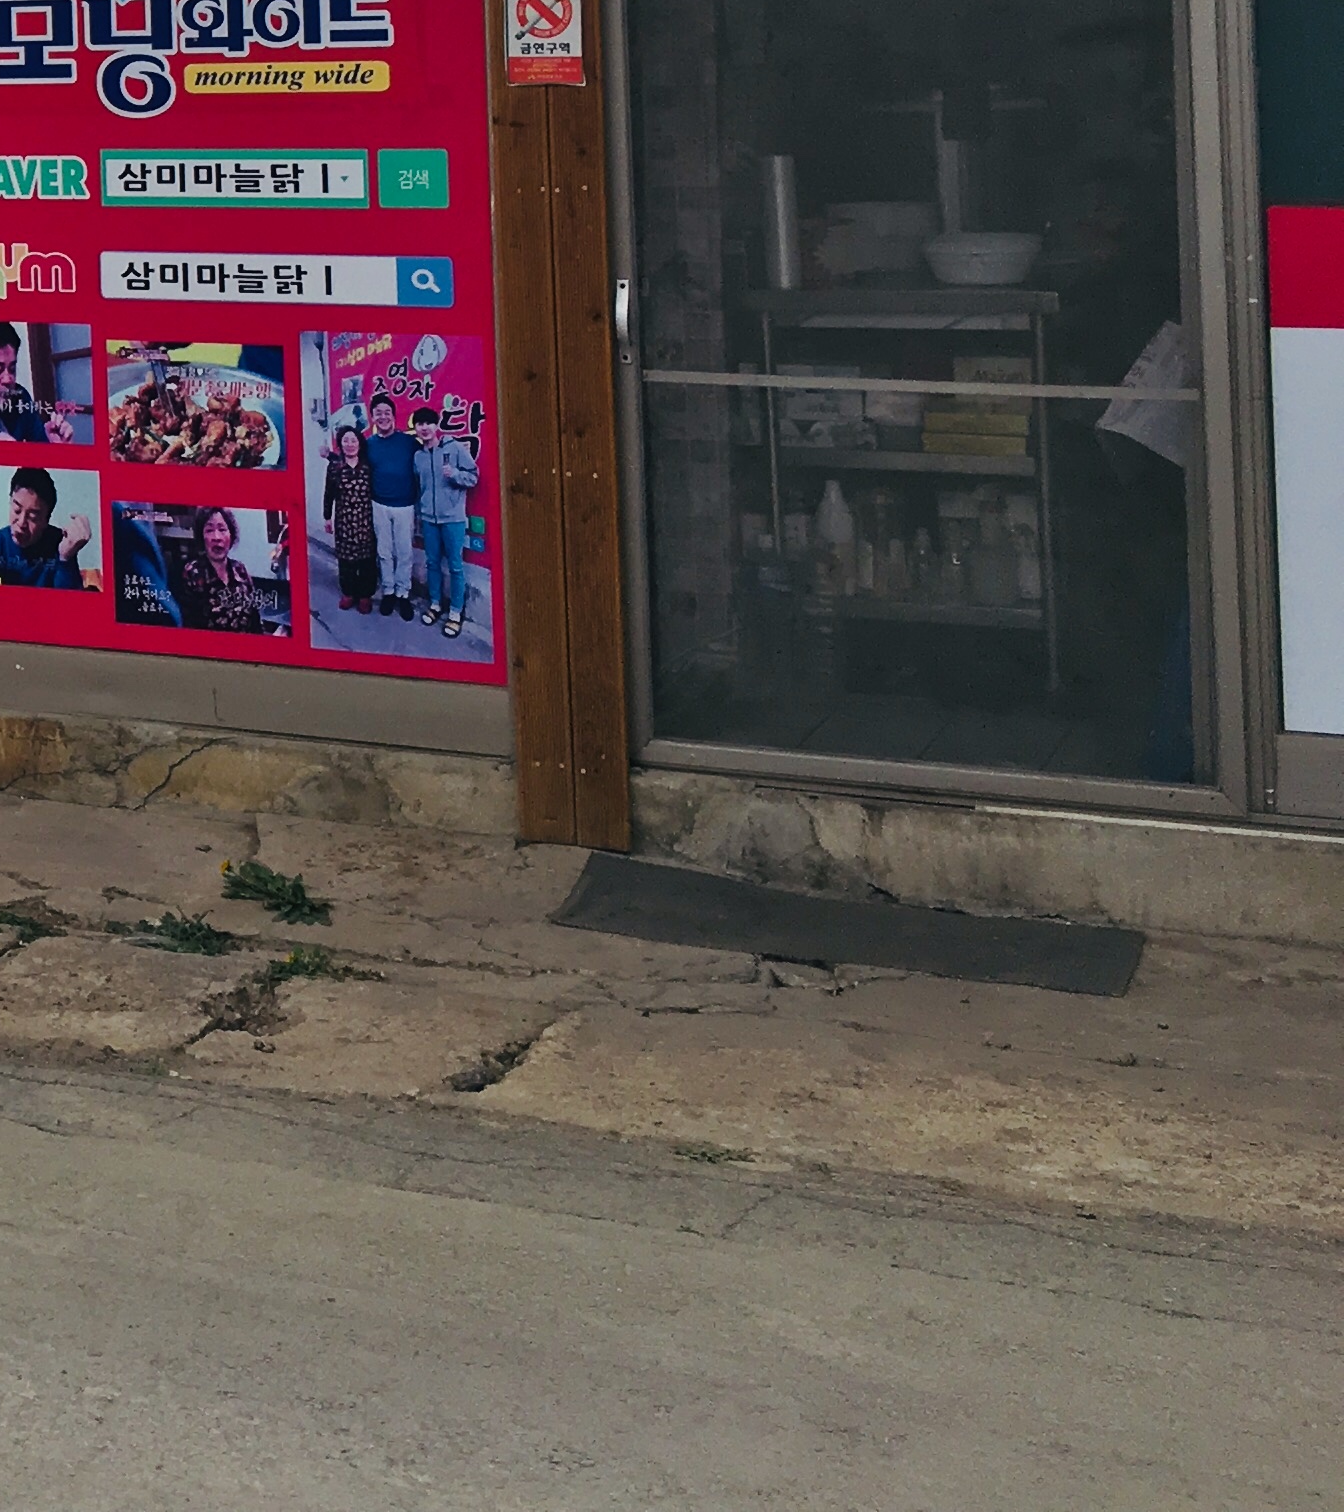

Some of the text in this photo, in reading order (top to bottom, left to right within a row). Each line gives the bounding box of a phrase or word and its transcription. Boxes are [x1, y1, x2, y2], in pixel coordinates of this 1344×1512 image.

[519, 42, 571, 55] 금연구역
[192, 64, 376, 91] morning wide
[116, 161, 306, 195] 삼미마늘닭
[396, 168, 431, 191] 검색
[119, 261, 309, 296] 삼미마늘닭
